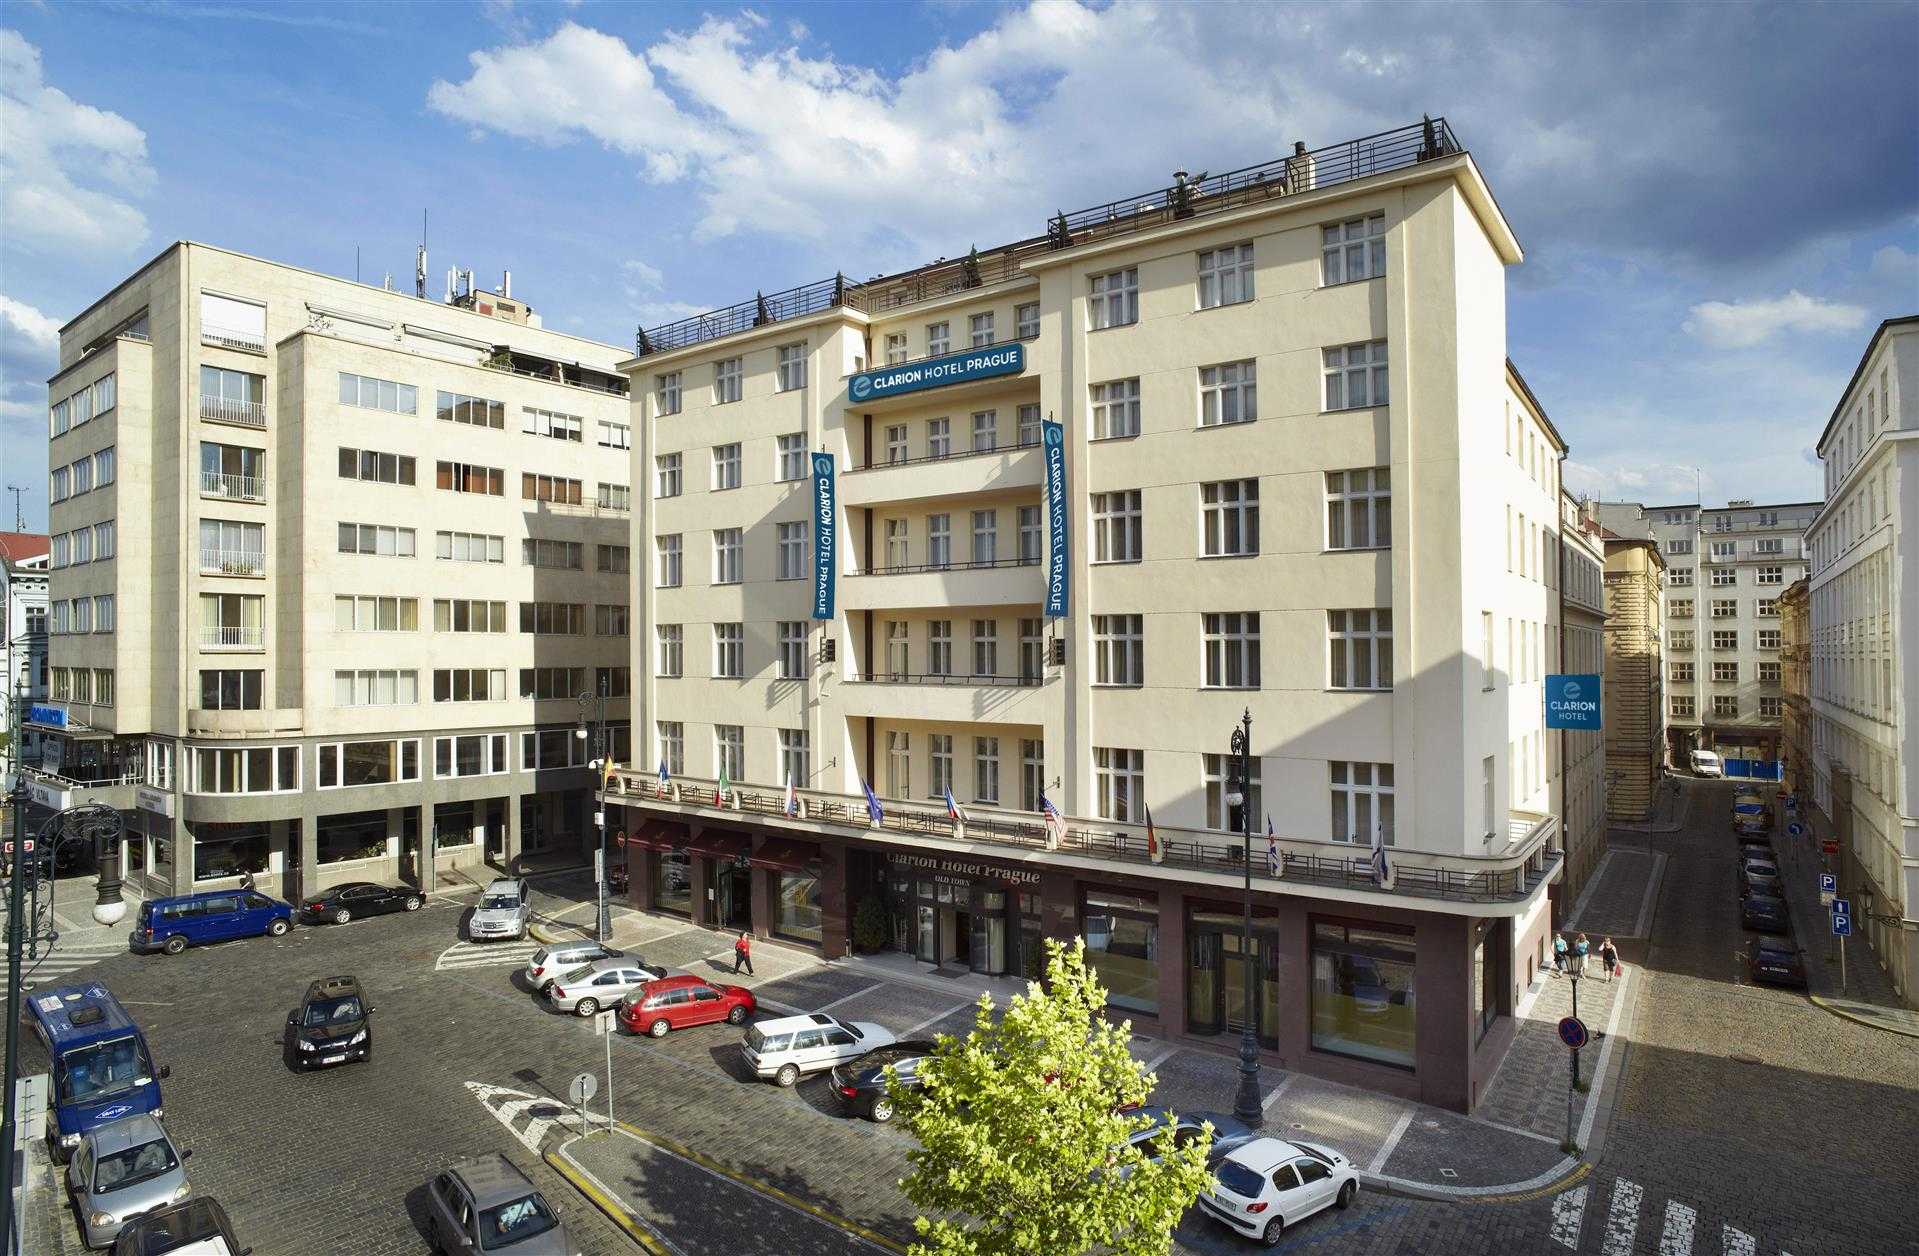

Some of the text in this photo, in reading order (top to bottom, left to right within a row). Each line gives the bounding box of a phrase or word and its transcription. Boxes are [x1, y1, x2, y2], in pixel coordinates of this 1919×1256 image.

[873, 351, 1018, 390] CLARION HOTEL PRAGUE
[1050, 447, 1064, 611] CLARION HOTEL PRAGUE
[818, 478, 832, 614] CLARION HOTEL PRAGUE
[1550, 701, 1596, 711] CLARION
[1558, 712, 1588, 721] HOTEL
[981, 863, 1042, 885] Prague
[1823, 876, 1833, 887] P
[1835, 916, 1847, 928] P
